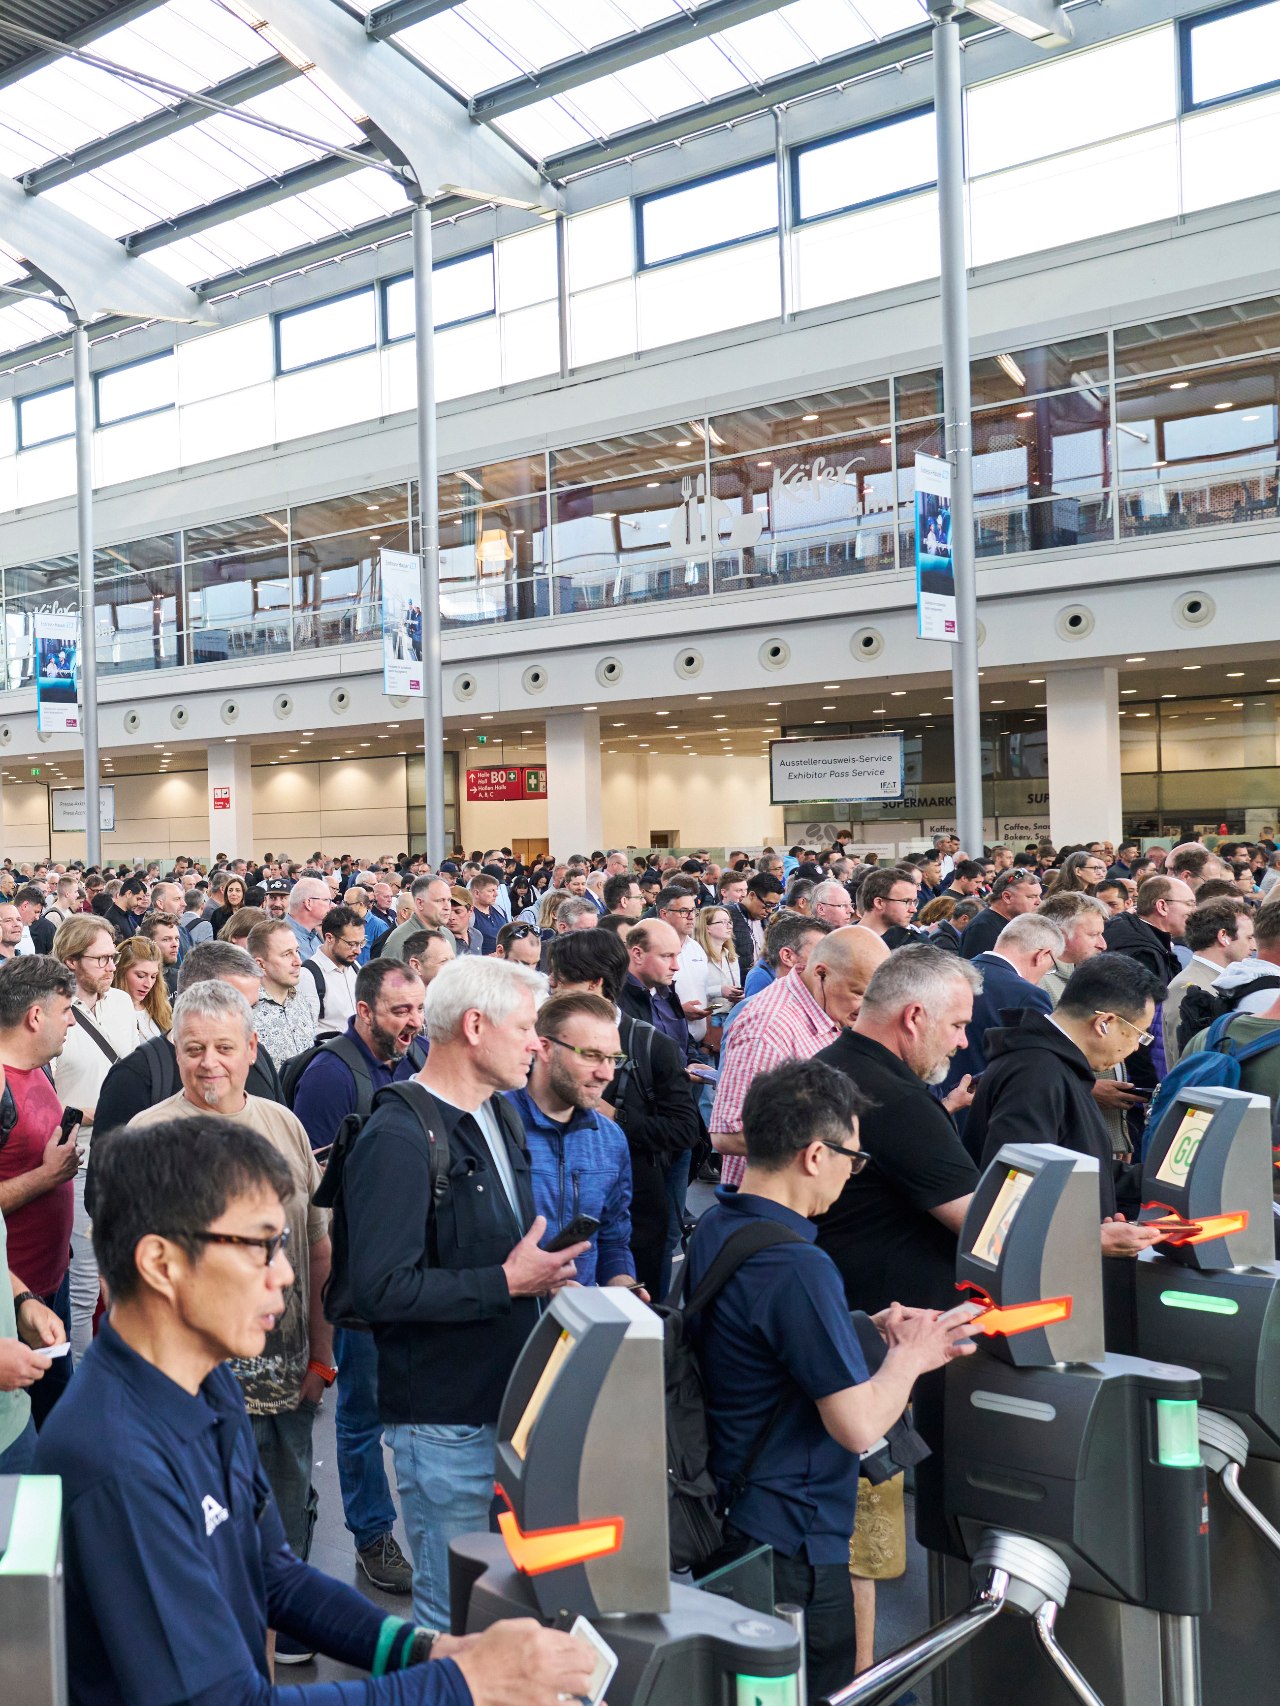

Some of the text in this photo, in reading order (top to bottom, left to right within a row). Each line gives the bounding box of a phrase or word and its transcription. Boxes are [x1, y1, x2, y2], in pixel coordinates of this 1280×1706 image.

[772, 456, 866, 501] Käfer
[779, 754, 893, 768] Ausstellerausweis-Service
[787, 768, 886, 780] Exhibitor Pass Service
[929, 825, 957, 834] Kaffee,
[1004, 823, 1032, 832] Coffee,
